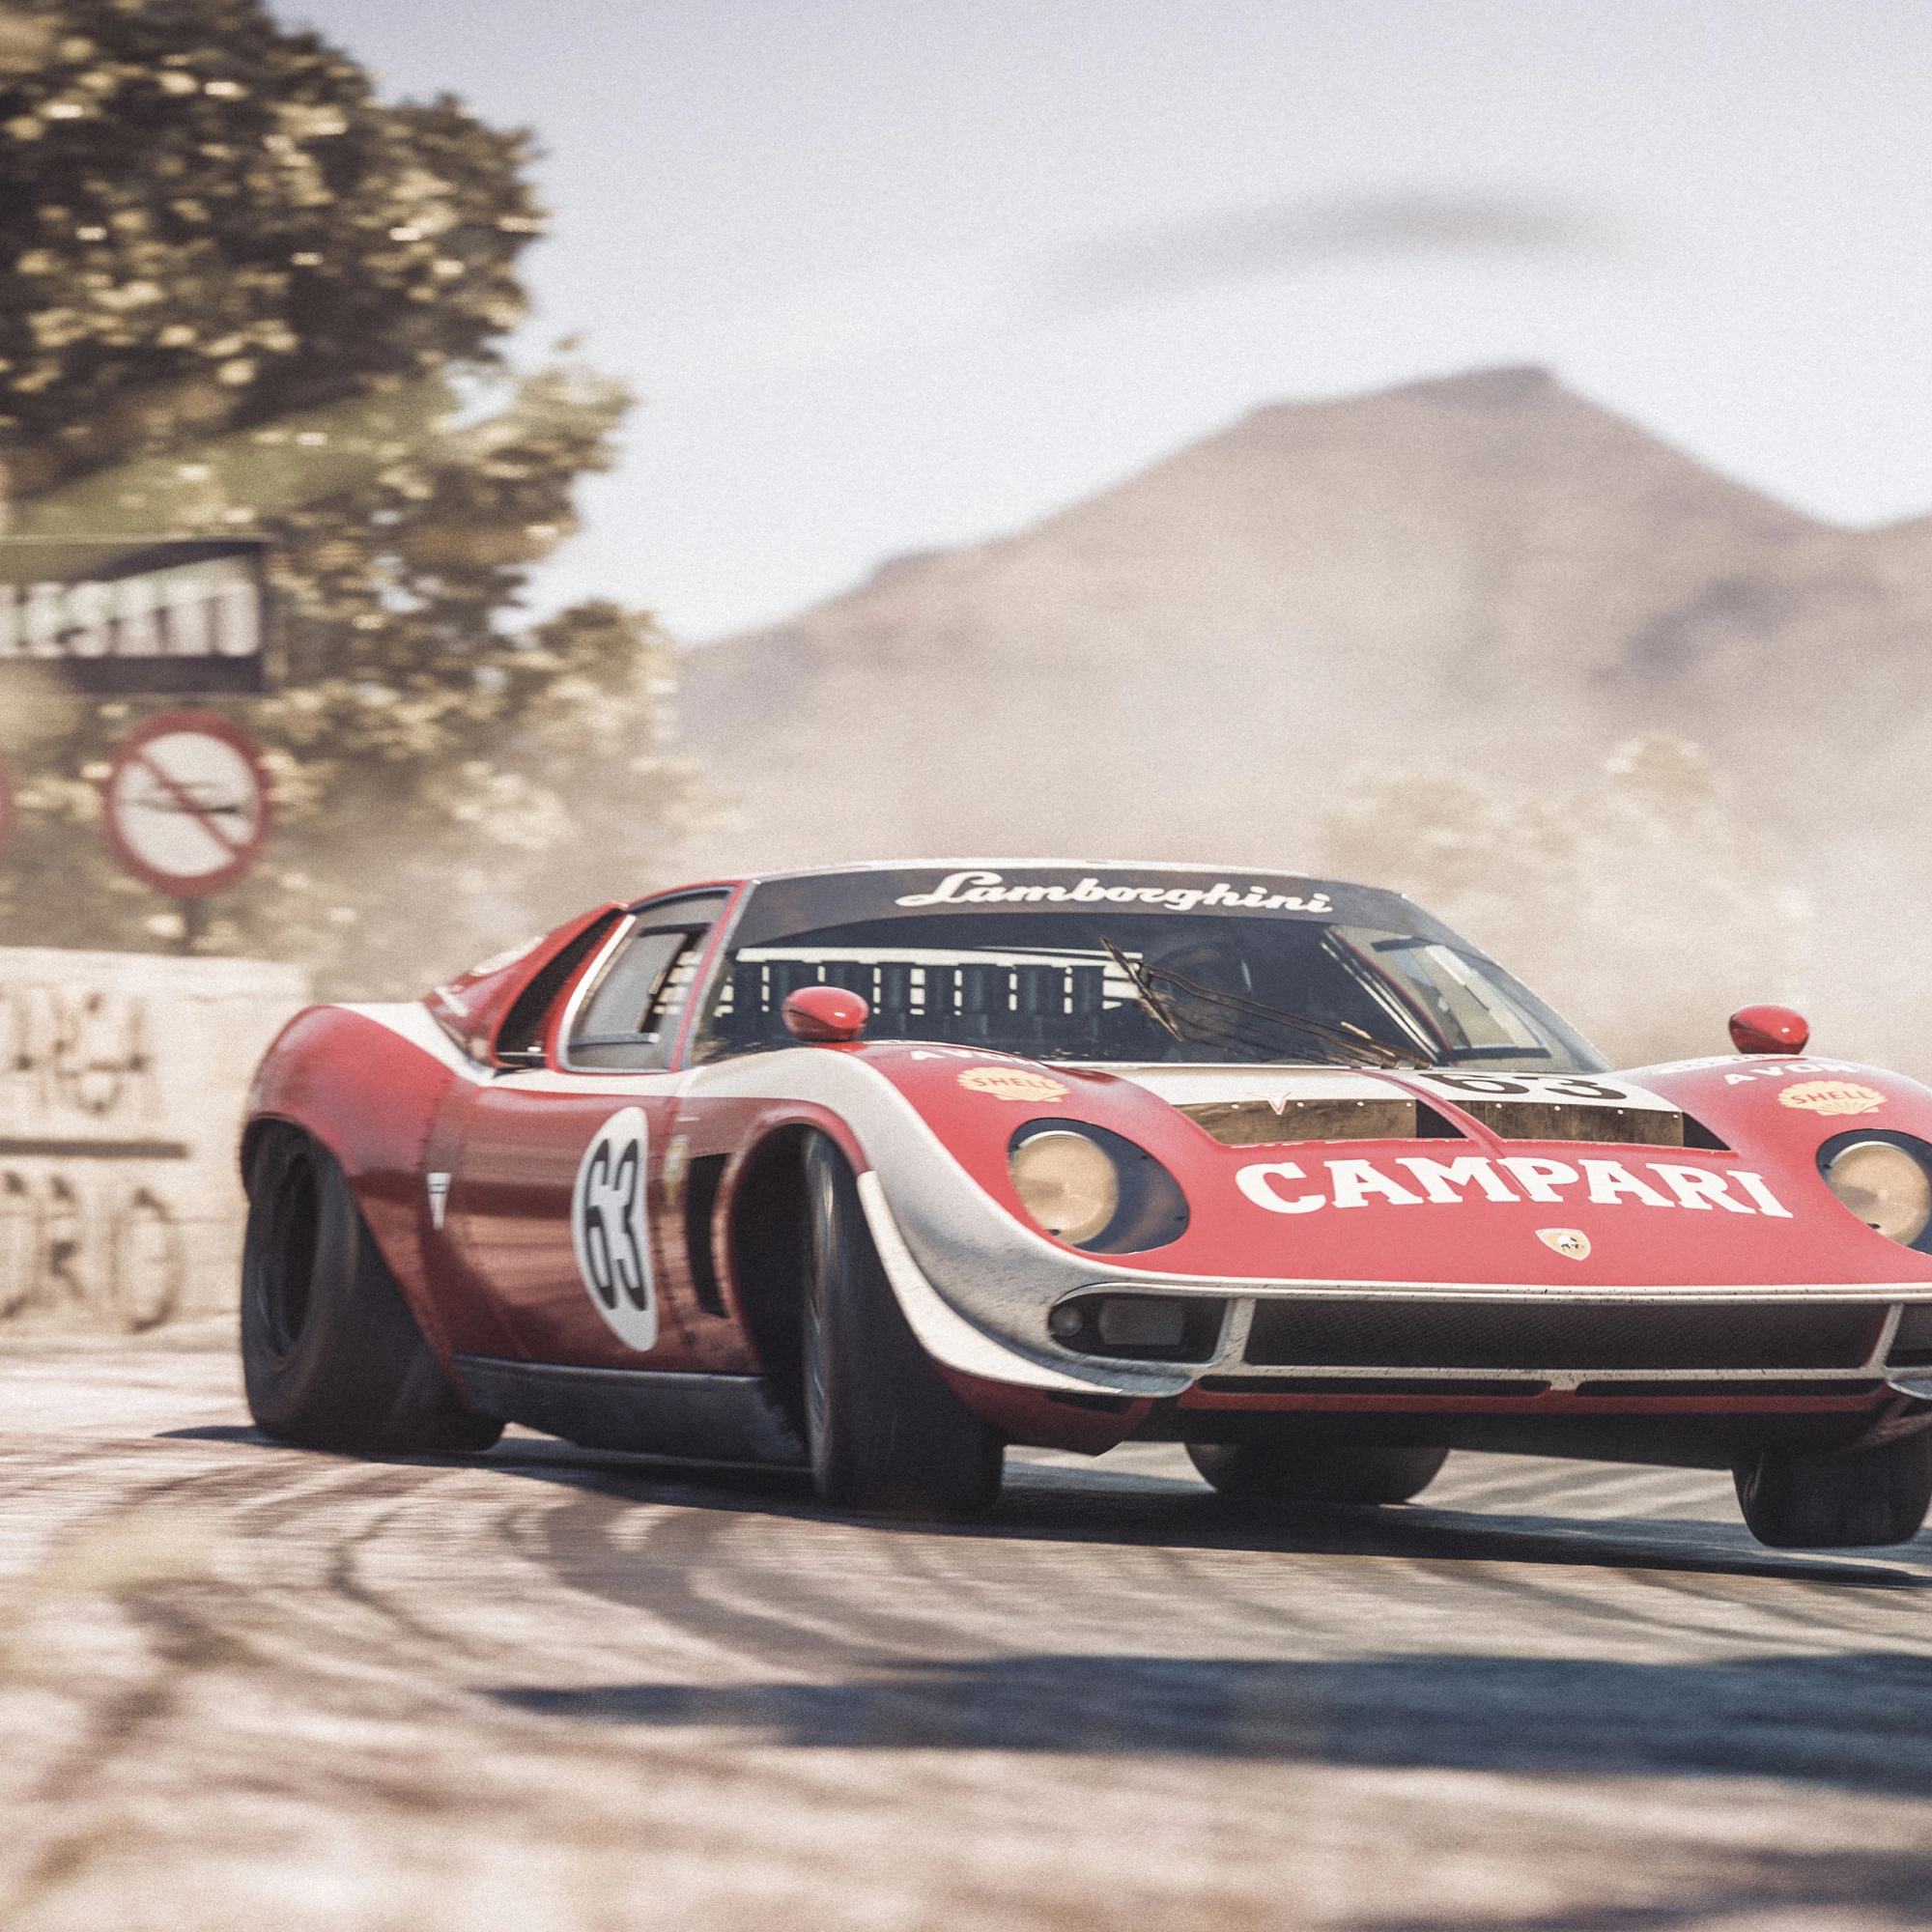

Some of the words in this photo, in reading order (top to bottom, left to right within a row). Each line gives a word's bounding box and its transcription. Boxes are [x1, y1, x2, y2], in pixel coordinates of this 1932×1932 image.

[895, 870, 1333, 914] Lamborghini
[972, 1076, 1055, 1090] SHELL
[1723, 1063, 1860, 1085] AVON
[1790, 1090, 1875, 1104] SHELL
[1235, 1156, 1794, 1219] CAMPARI
[582, 1137, 647, 1312] 63
